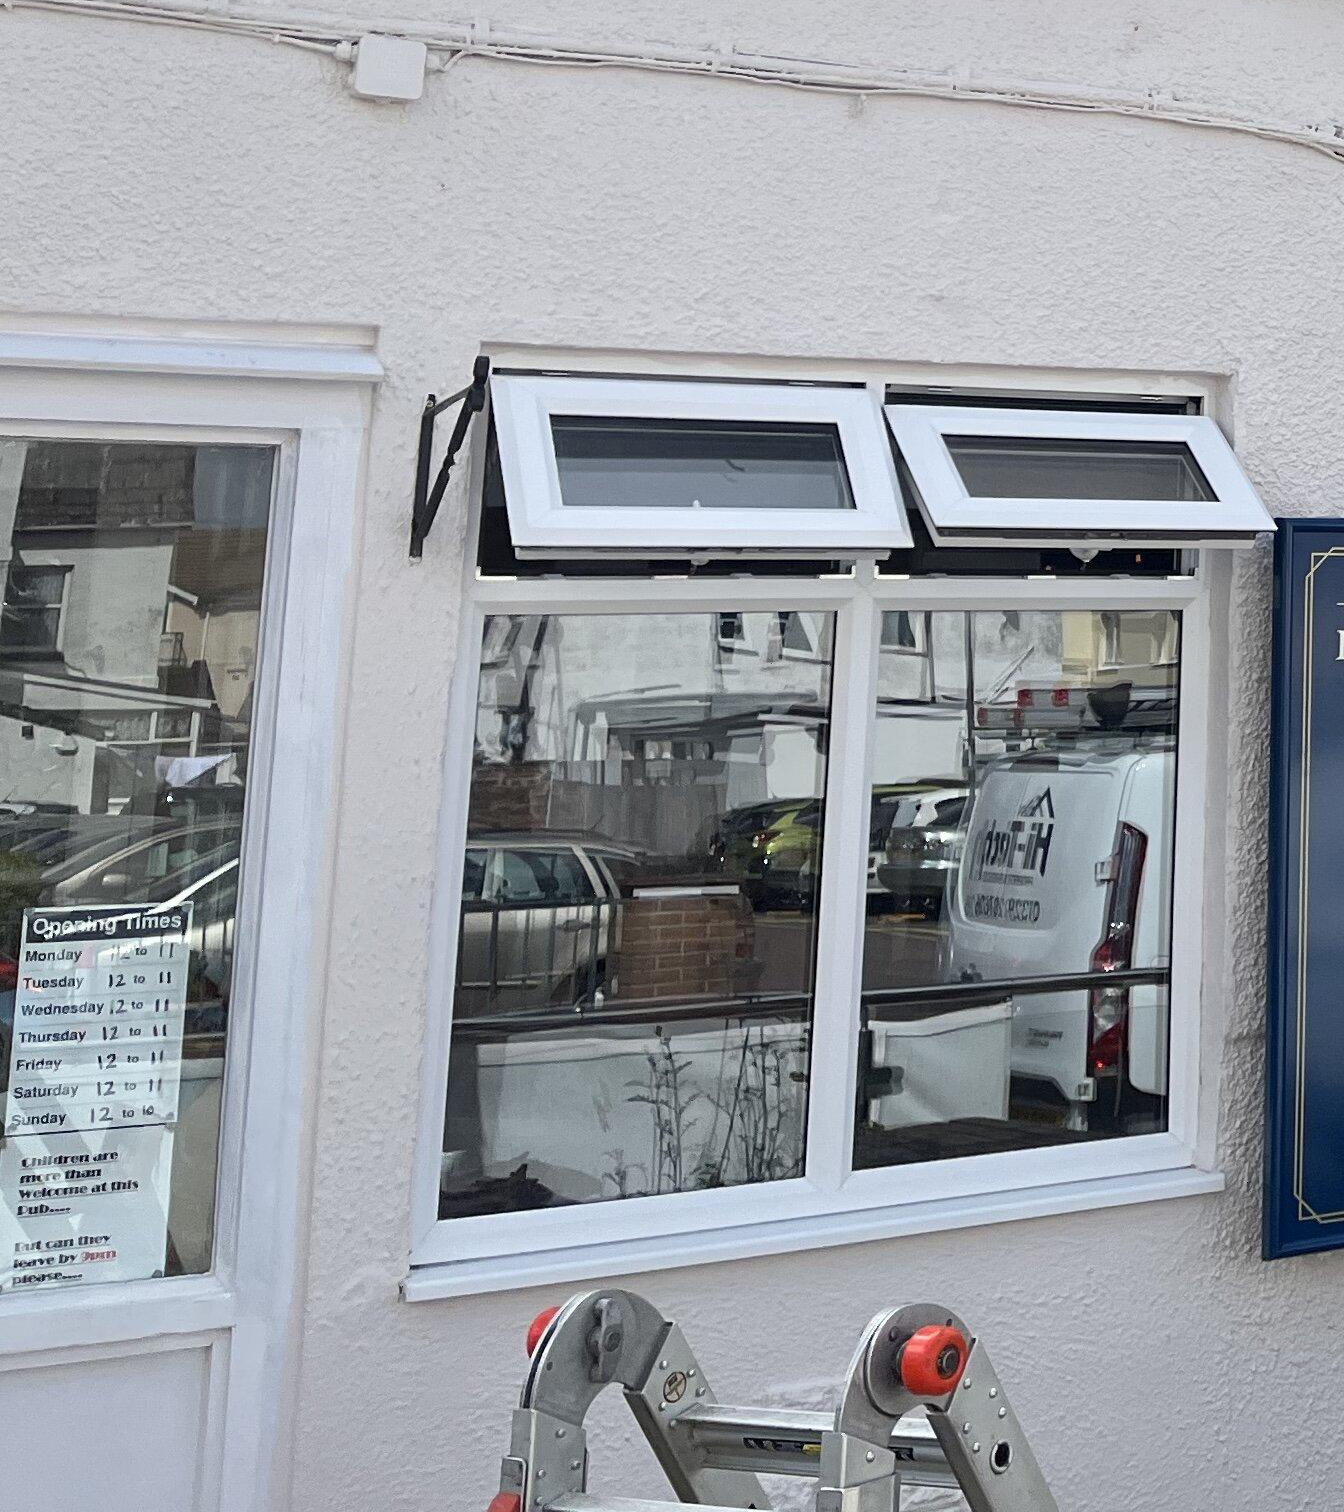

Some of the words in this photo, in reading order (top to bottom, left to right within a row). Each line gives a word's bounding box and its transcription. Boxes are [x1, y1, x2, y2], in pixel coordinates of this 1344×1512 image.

[33, 916, 117, 940] Opening
[125, 912, 182, 932] Times
[26, 949, 83, 964] Monday
[135, 945, 148, 957] to
[23, 975, 84, 989] Tuesday
[108, 974, 126, 987] 12
[133, 974, 146, 984] to
[21, 1001, 105, 1016] Wednesday
[109, 999, 128, 1014] 12
[131, 1000, 144, 1010] to
[19, 1029, 87, 1044] Thursday
[102, 1026, 119, 1040] 12
[129, 1027, 142, 1037] to
[16, 1057, 63, 1073] Friday
[98, 1053, 117, 1069] 12
[127, 1054, 140, 1064] to
[13, 1083, 80, 1100] Saturday
[97, 1080, 115, 1097] 12
[124, 1081, 137, 1092] to
[11, 1111, 67, 1128] Sunday
[122, 1107, 135, 1118] to
[20, 1154, 90, 1167] Children
[92, 1151, 119, 1162] are
[19, 1173, 61, 1184] more
[64, 1168, 101, 1179] than
[18, 1185, 88, 1199] Welcome
[91, 1182, 107, 1193] at
[111, 1179, 139, 1191] this
[45, 1238, 74, 1249] can
[77, 1234, 113, 1246] they
[58, 1253, 79, 1264] by
